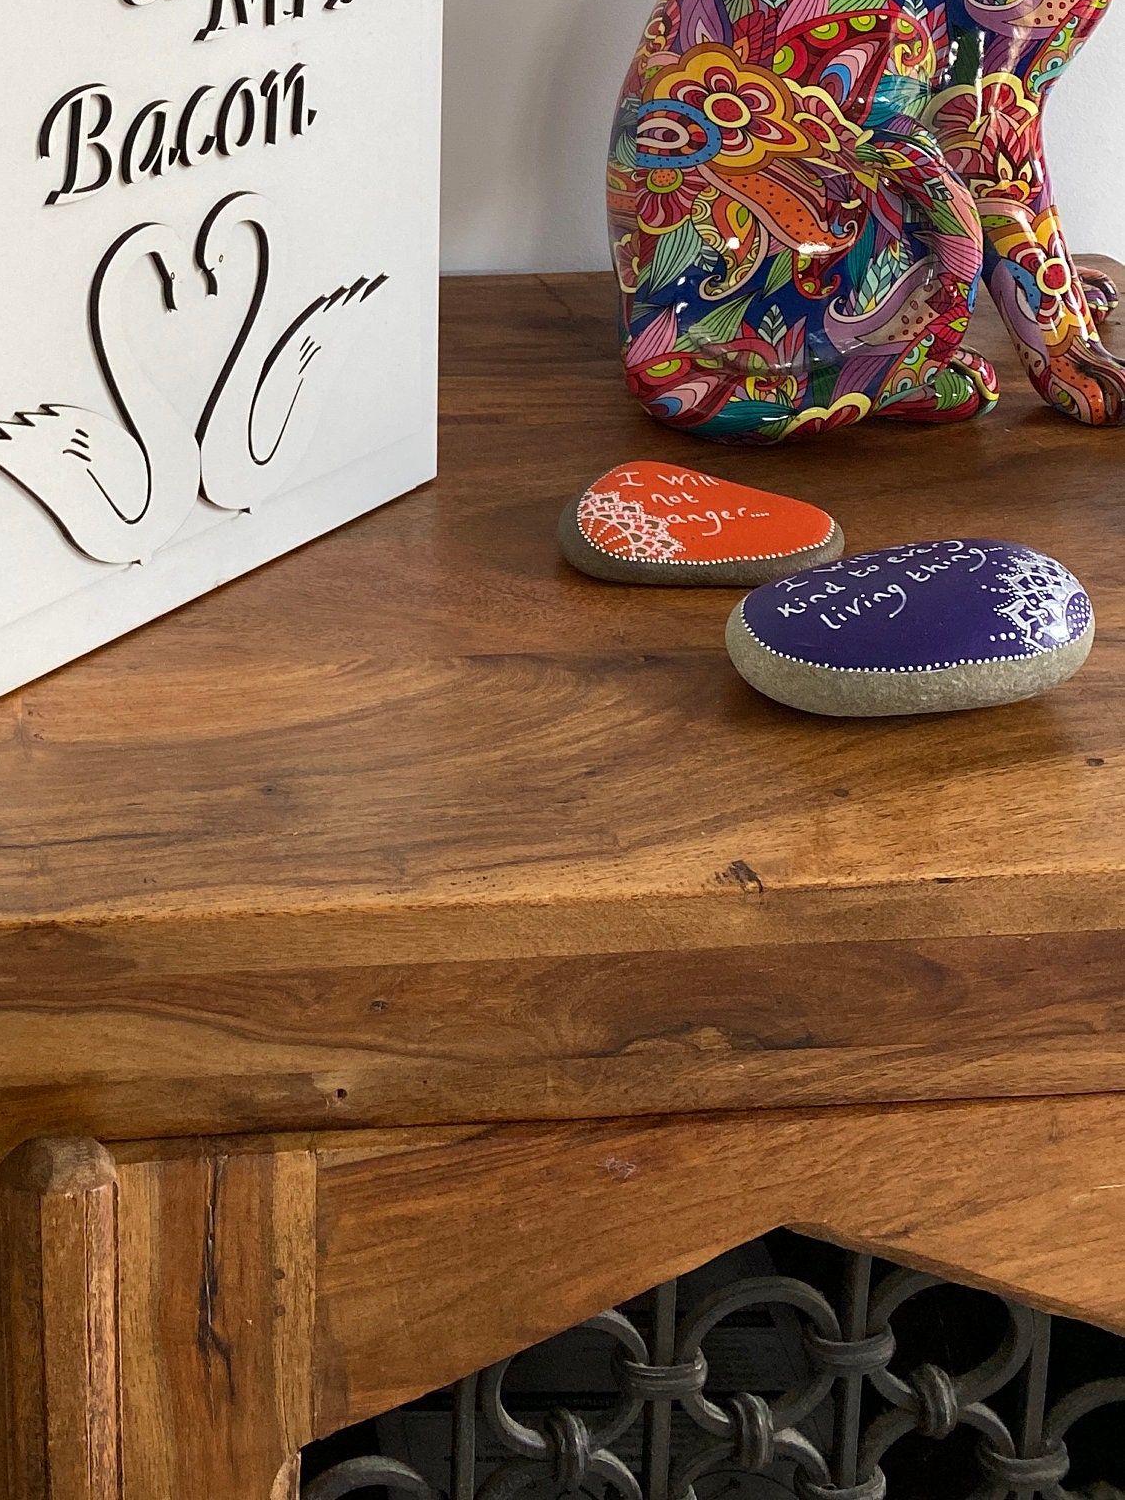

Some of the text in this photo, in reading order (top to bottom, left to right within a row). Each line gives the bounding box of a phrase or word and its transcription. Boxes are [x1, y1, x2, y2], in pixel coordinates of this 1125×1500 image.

[38, 62, 317, 206] Bacon
[615, 471, 645, 487] I
[848, 564, 880, 578] to
